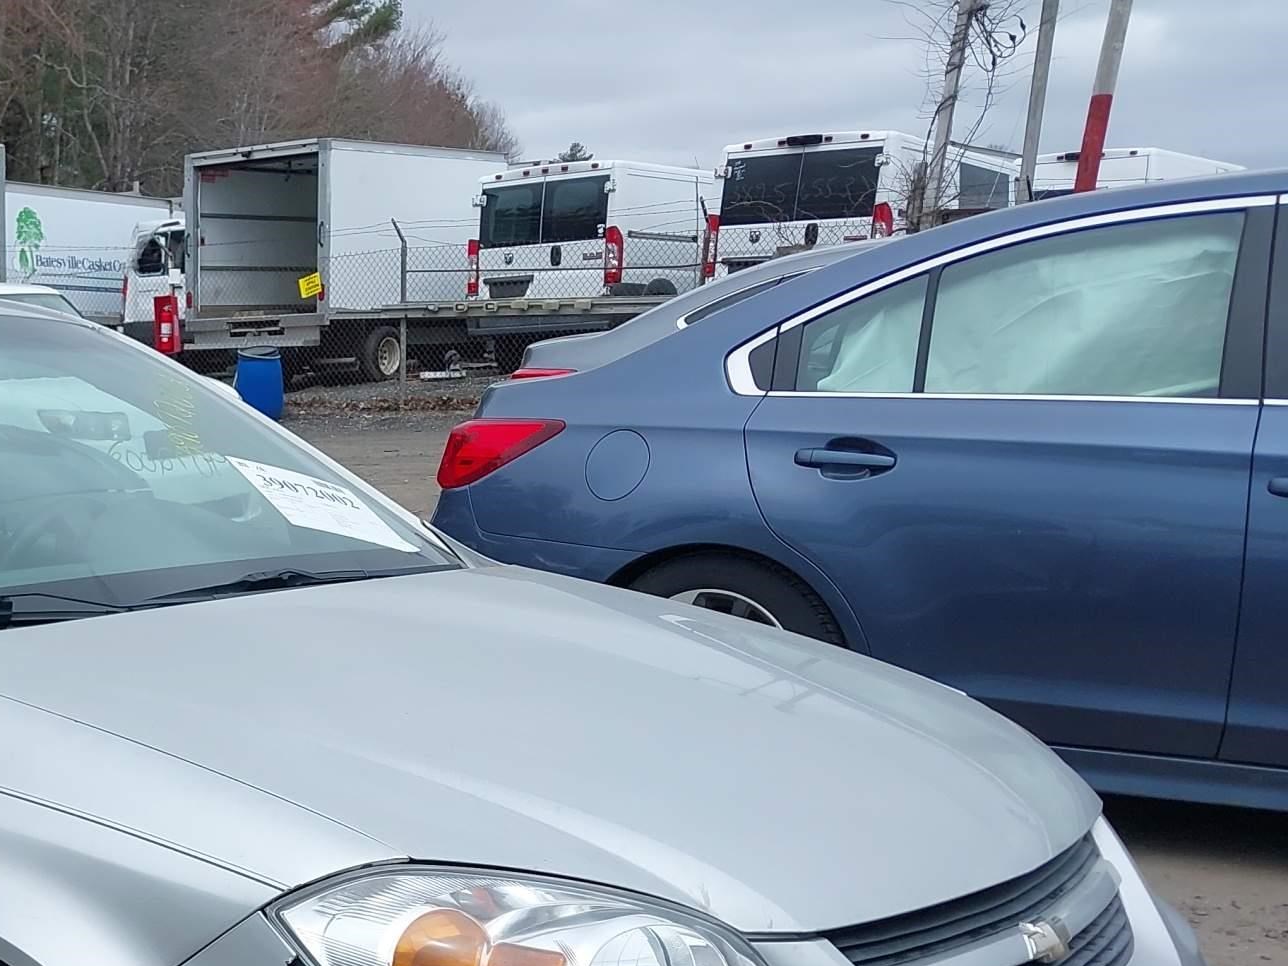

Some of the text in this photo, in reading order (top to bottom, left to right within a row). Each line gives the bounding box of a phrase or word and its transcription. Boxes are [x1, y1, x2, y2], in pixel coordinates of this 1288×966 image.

[35, 254, 80, 269] Batesville
[82, 257, 112, 272] Casket
[256, 474, 361, 510] 39072002
